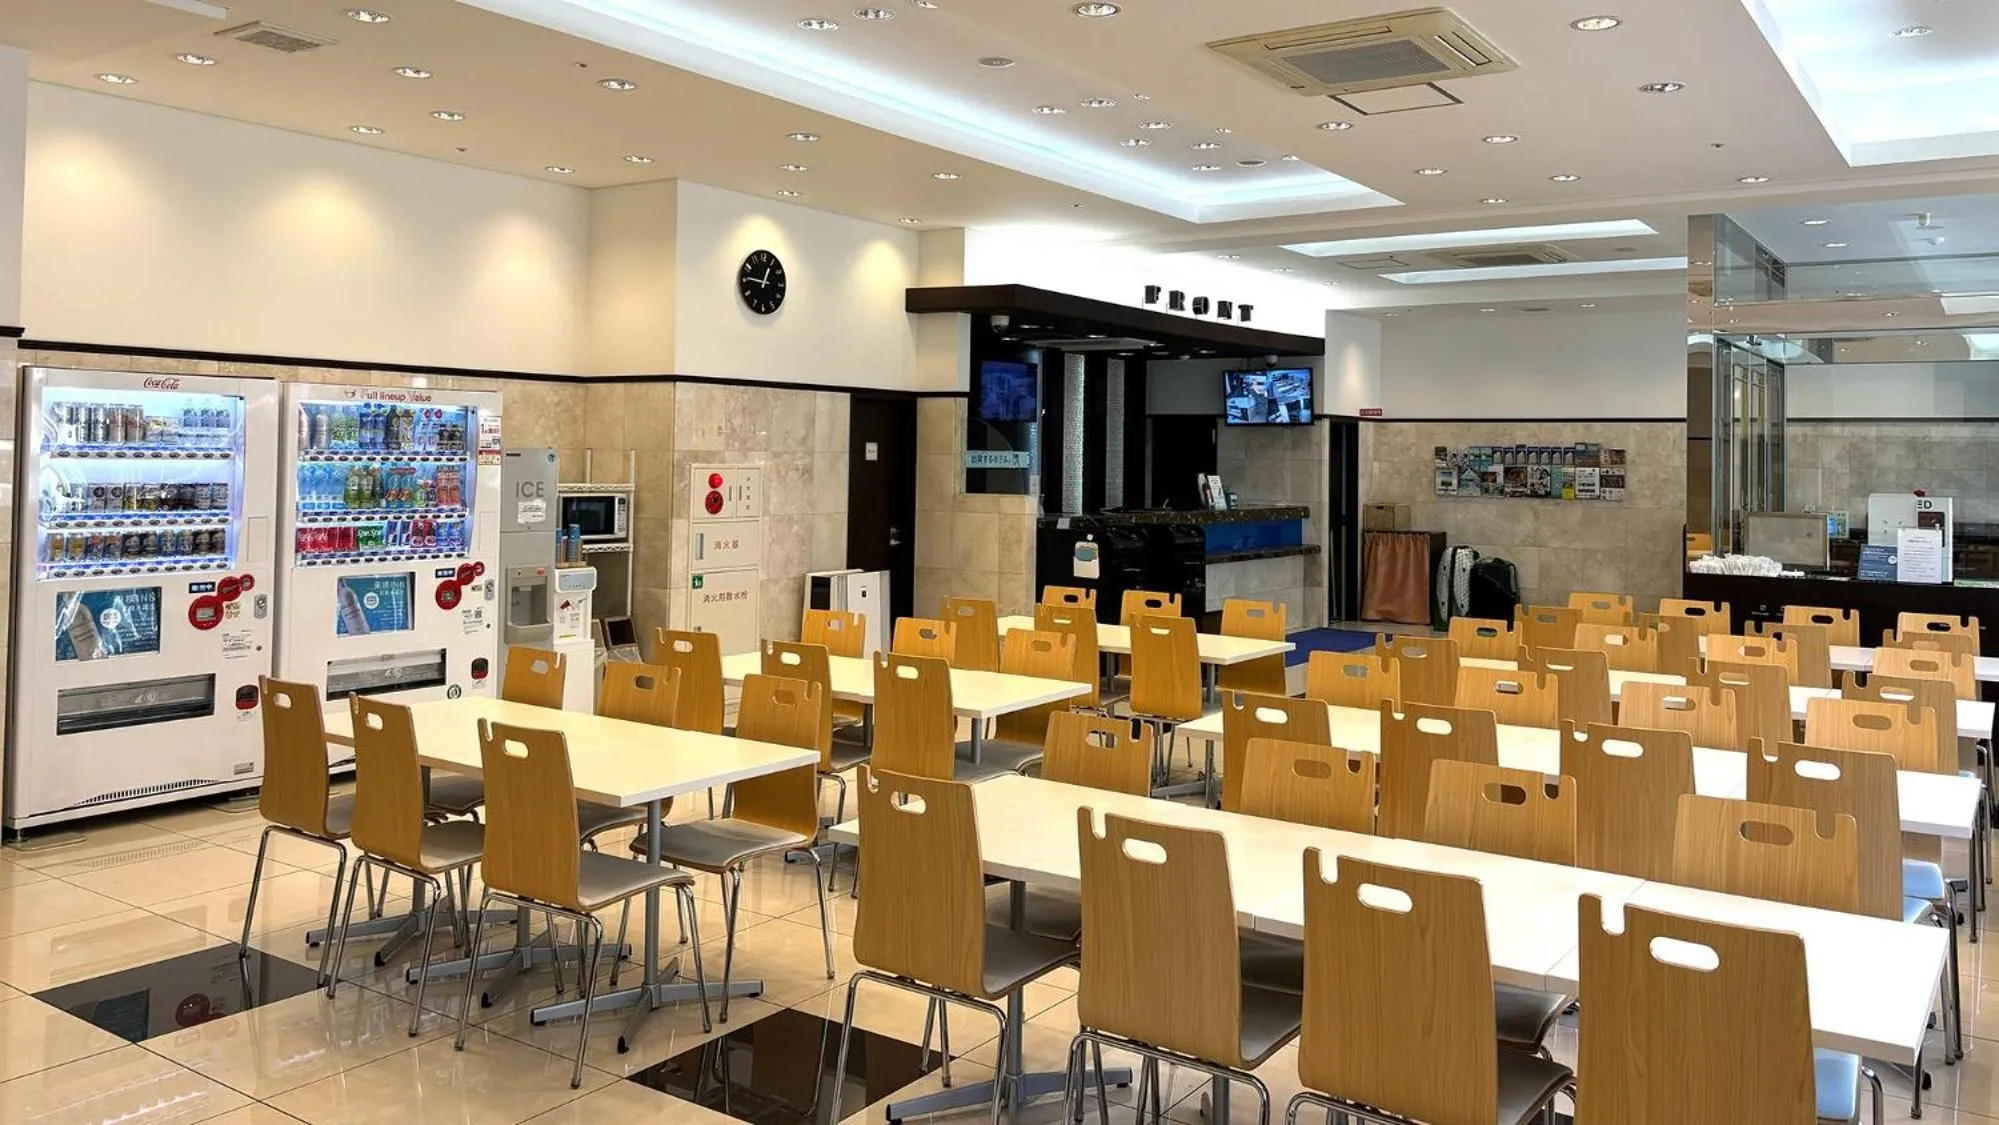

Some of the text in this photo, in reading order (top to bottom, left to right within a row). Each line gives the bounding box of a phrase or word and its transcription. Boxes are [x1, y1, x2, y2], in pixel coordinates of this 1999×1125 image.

[1145, 285, 1254, 322] FRONT
[379, 390, 406, 402] lineup
[516, 481, 545, 498] ICE
[713, 539, 739, 550] 消火器
